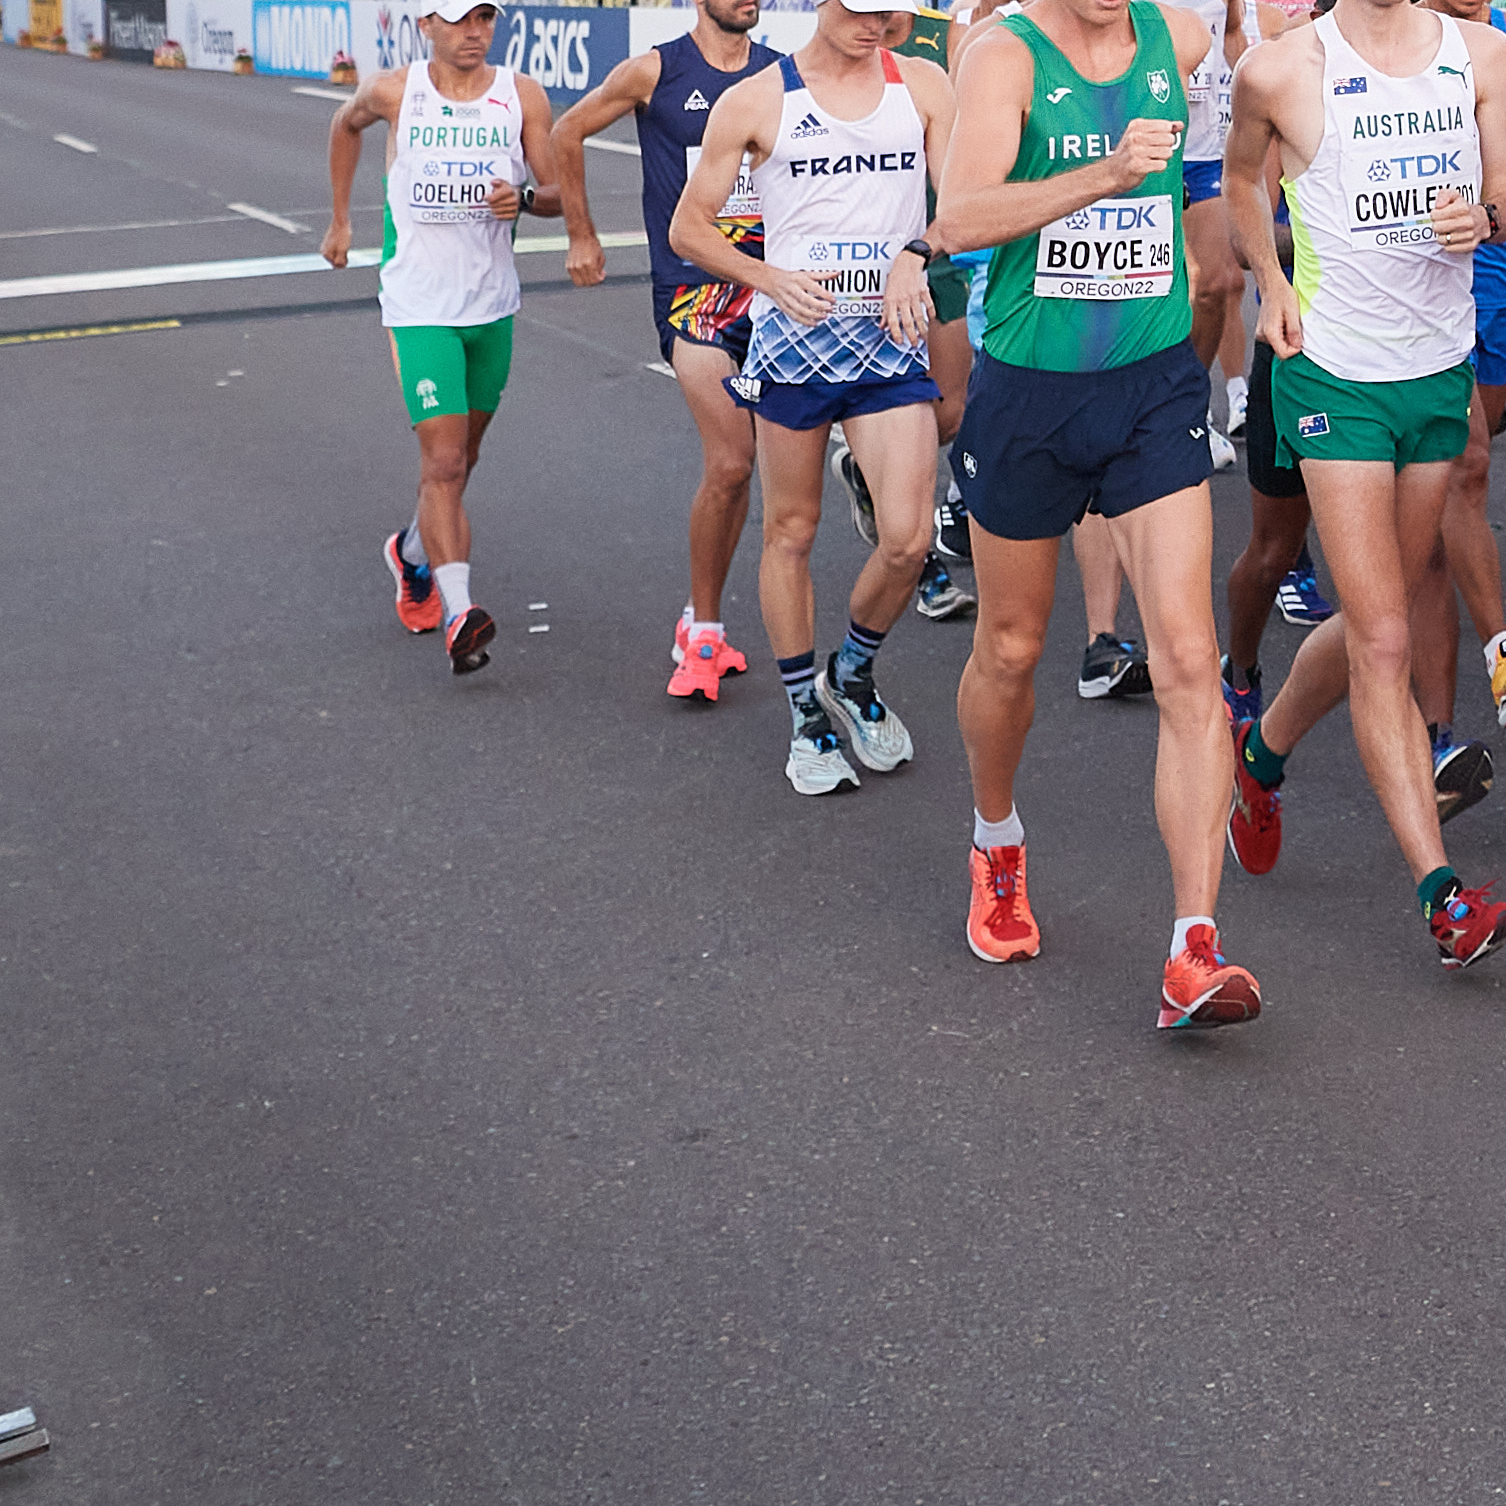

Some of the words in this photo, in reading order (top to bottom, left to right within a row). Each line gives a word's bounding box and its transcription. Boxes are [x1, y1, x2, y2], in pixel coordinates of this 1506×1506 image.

[528, 18, 590, 91] asics
[790, 126, 830, 140] adidas
[1352, 105, 1464, 140] AUSTRALIA
[409, 125, 510, 148] PORTUGAL
[441, 160, 496, 177] TDK
[789, 151, 917, 178] FRANCE
[1390, 149, 1462, 180] TDK
[412, 182, 486, 204] COELHO
[1355, 183, 1451, 223] COWLE
[1090, 203, 1157, 231] TDK
[829, 241, 892, 261] TDK
[1046, 238, 1144, 271] BOYCE
[1149, 242, 1170, 268] 246
[1060, 280, 1154, 297] OREGON22
